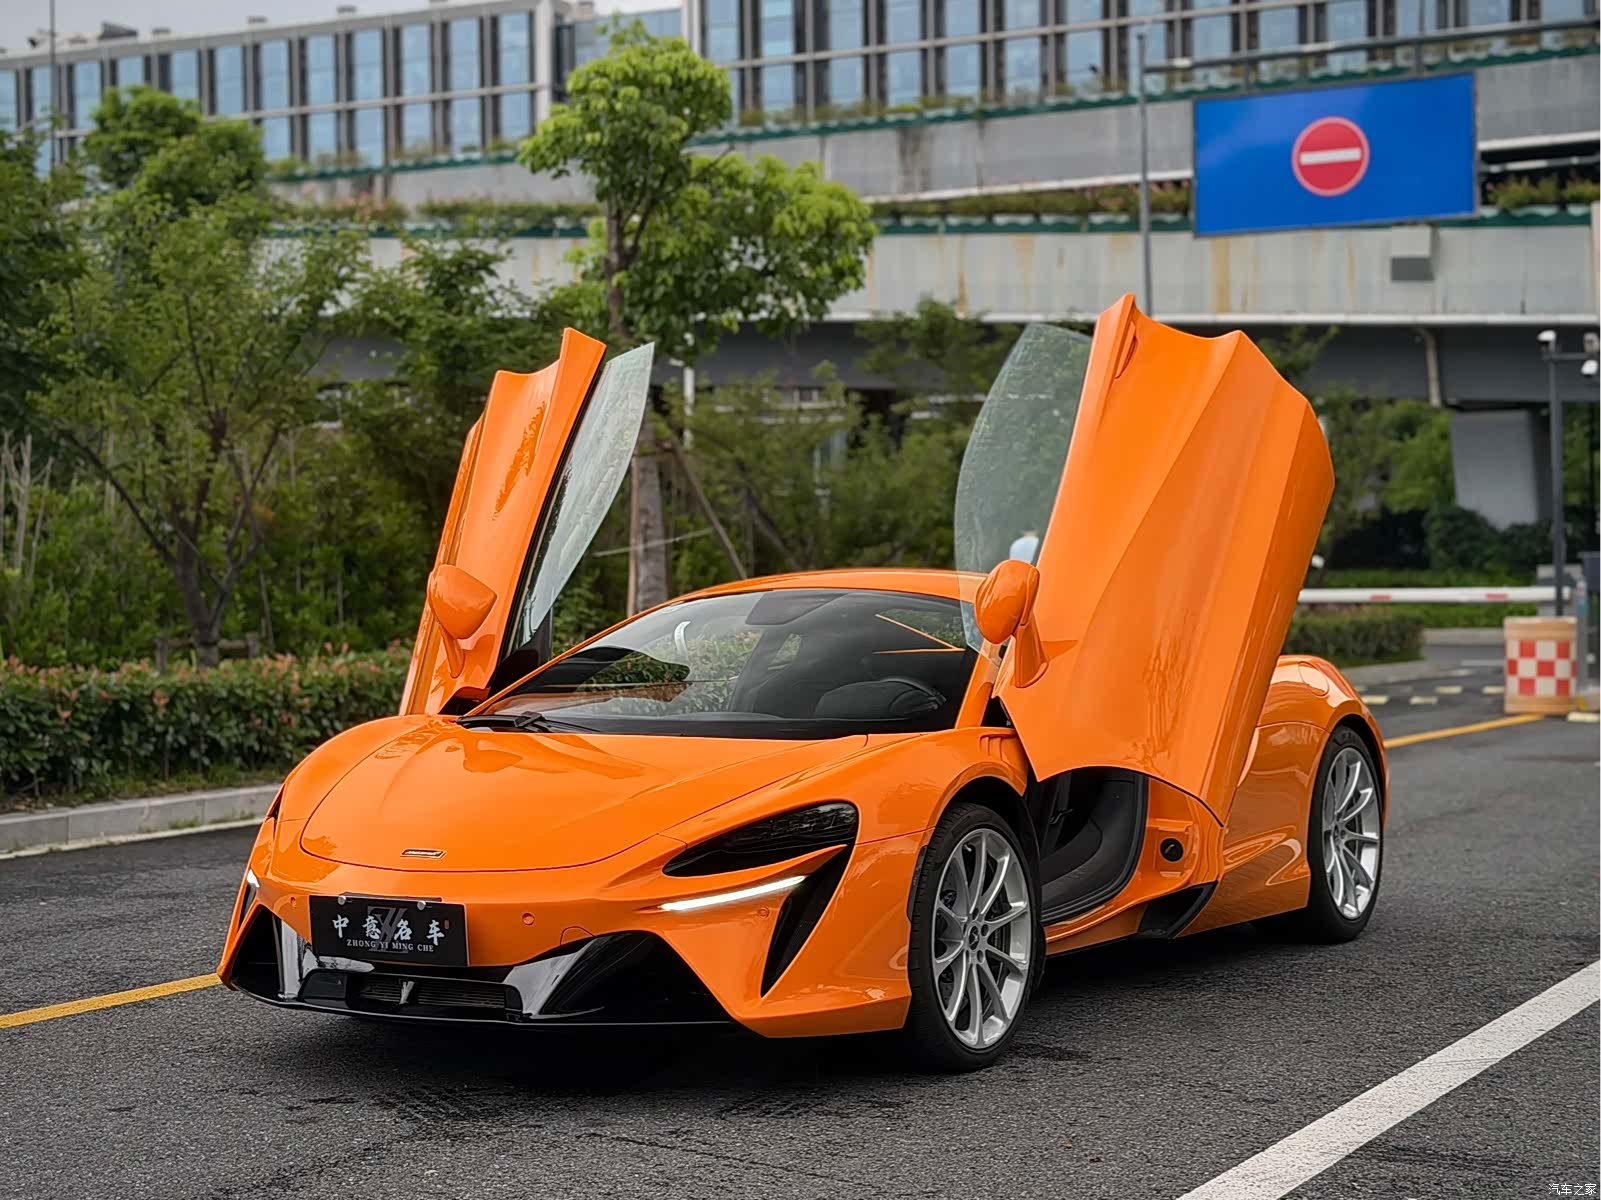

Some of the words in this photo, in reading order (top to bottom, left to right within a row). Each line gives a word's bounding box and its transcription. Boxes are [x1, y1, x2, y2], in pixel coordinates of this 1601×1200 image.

[332, 914, 445, 946] 中意名车
[346, 938, 376, 948] ZHONG
[380, 941, 389, 949] YI
[392, 942, 414, 951] MING
[417, 944, 434, 952] CHE
